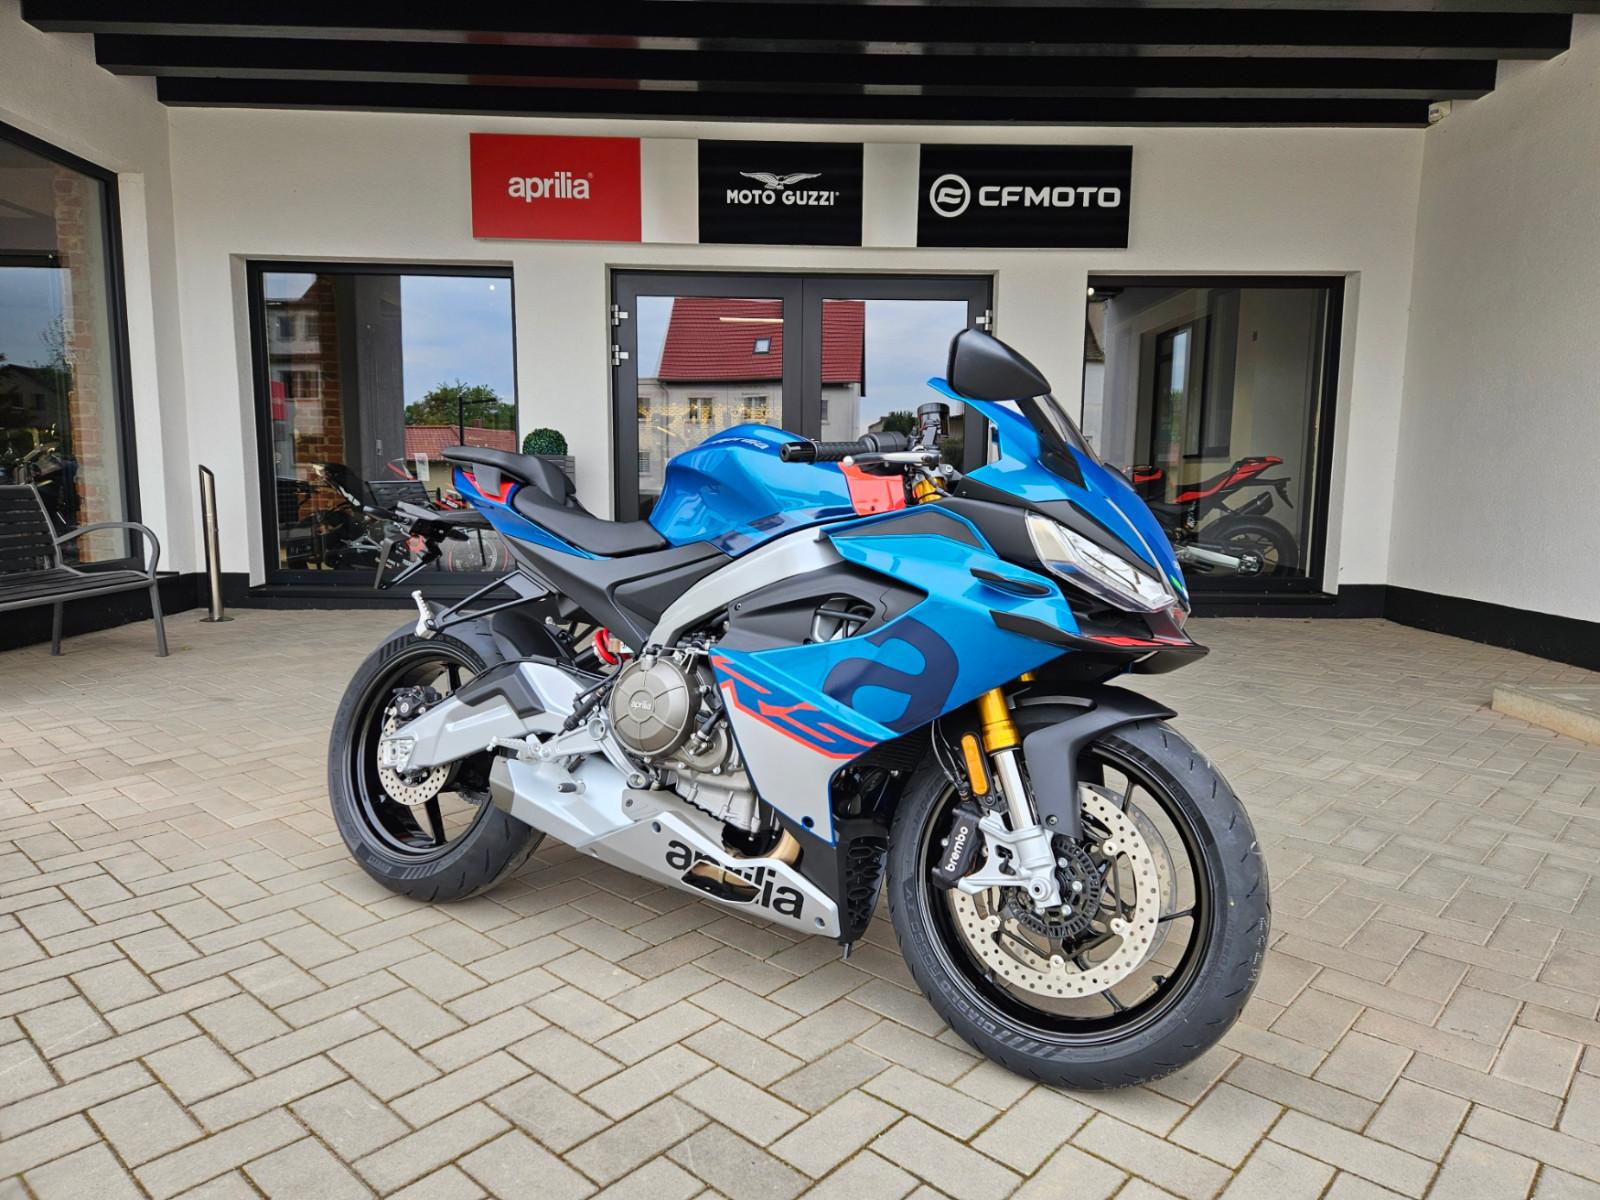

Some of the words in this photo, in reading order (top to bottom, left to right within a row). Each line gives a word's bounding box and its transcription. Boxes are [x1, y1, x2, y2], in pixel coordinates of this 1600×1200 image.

[508, 171, 590, 203] aprilia
[726, 189, 776, 204] MOTO
[781, 190, 835, 206] GUZZI
[978, 186, 1121, 207] CFMOTO
[944, 826, 969, 872] brembo
[665, 839, 805, 920] alia
